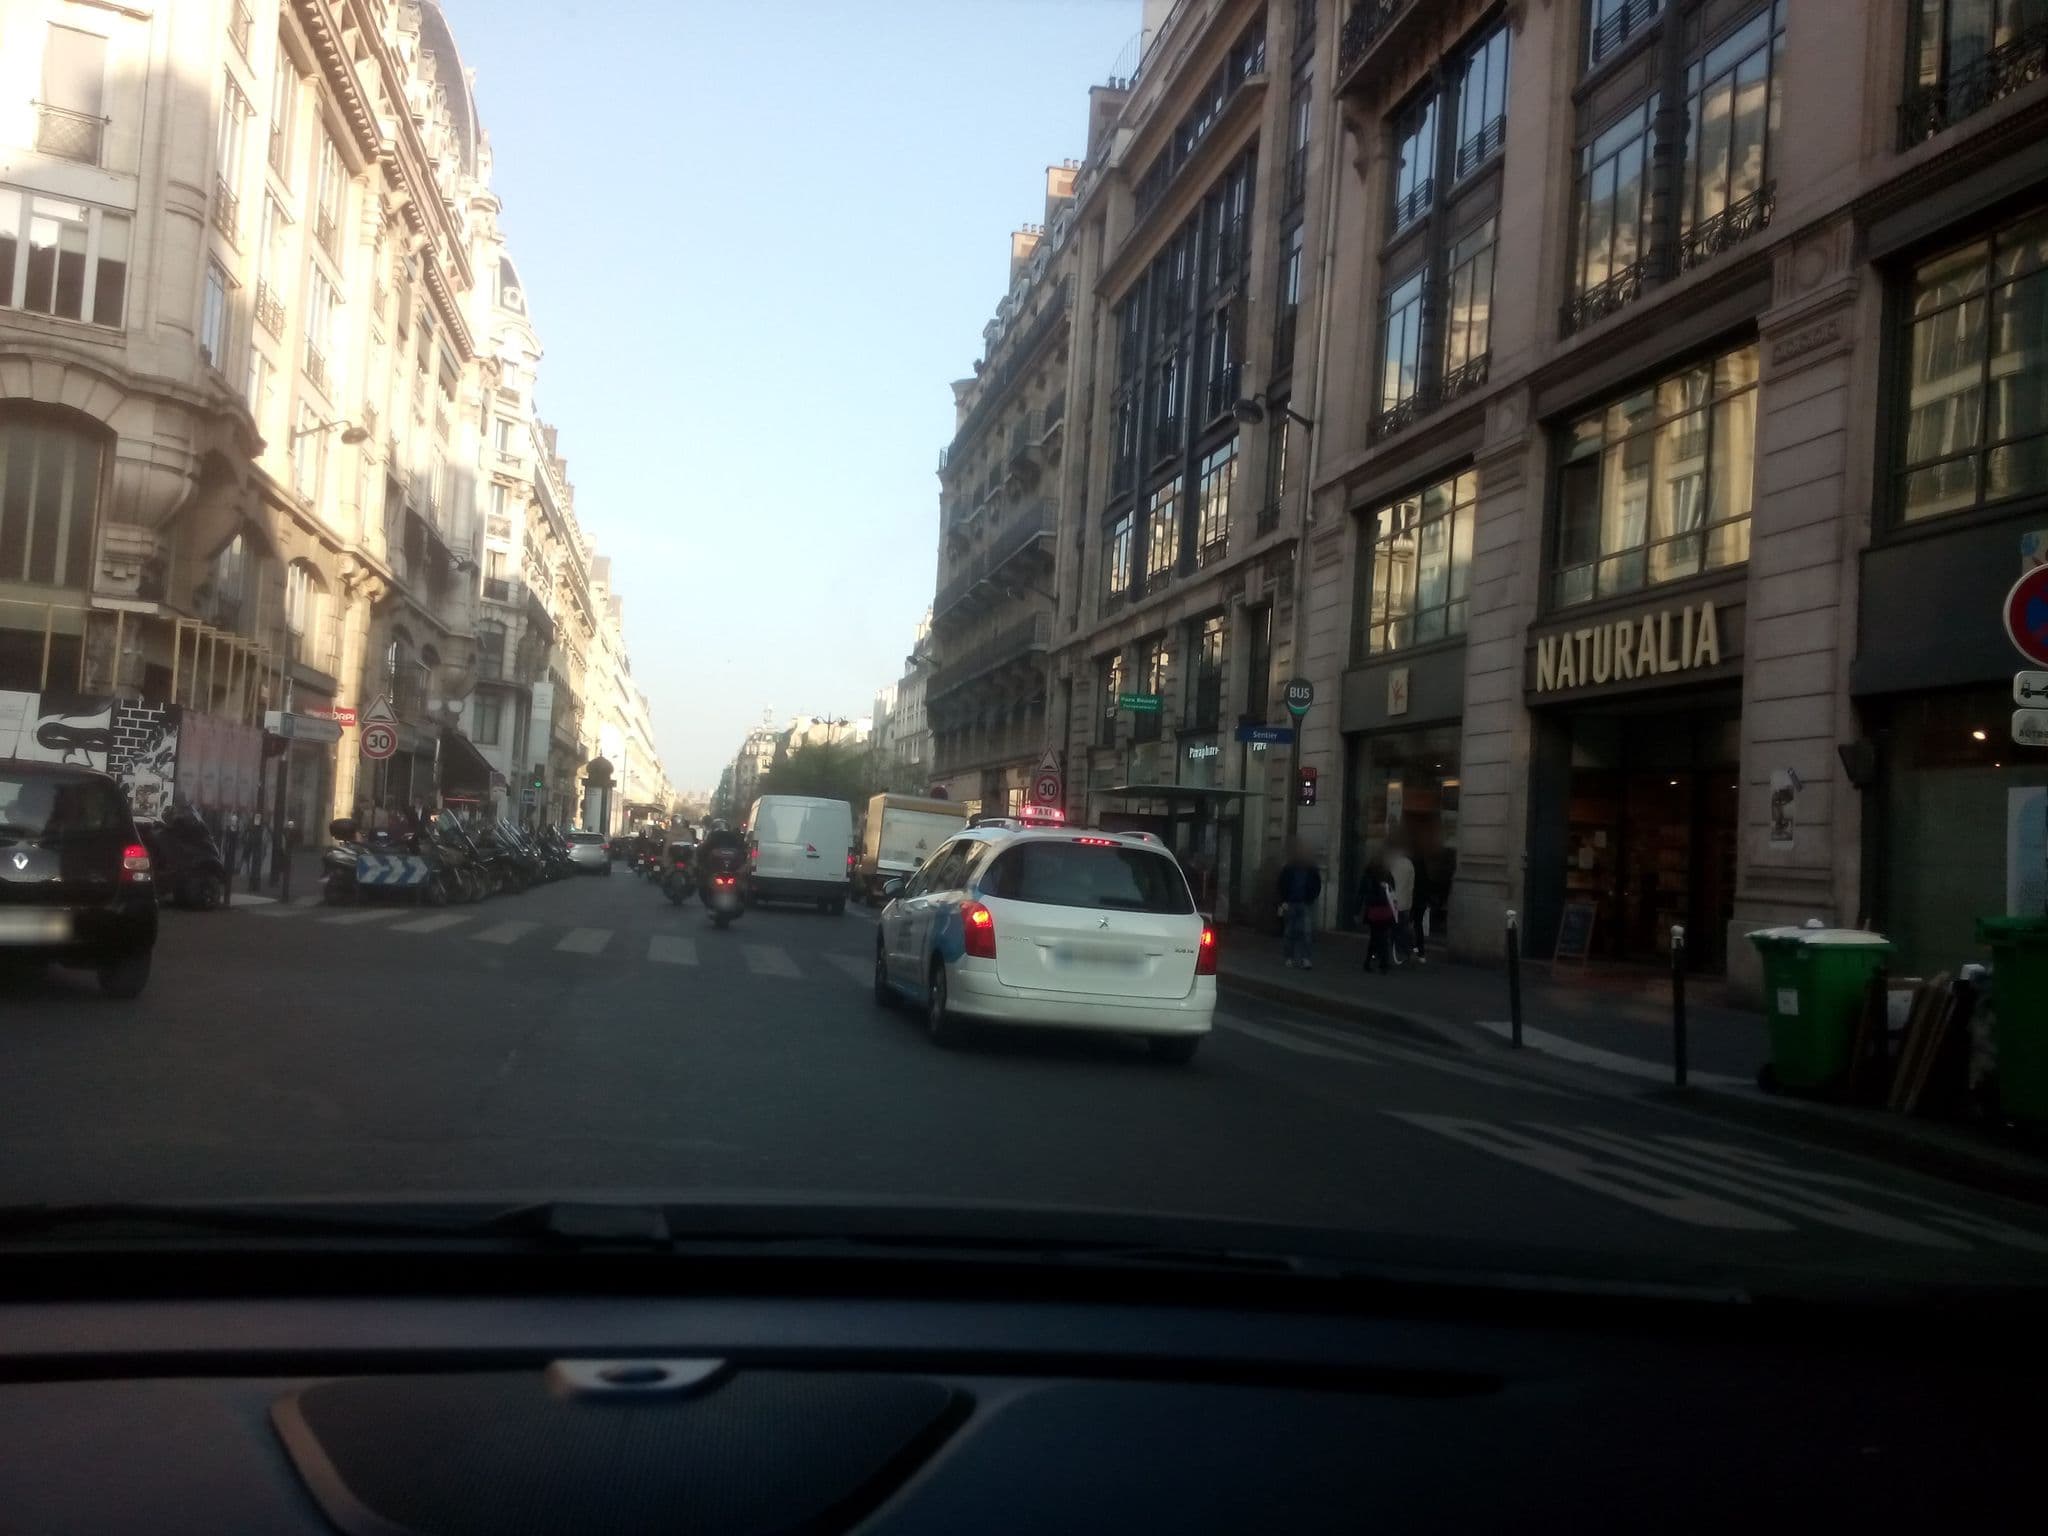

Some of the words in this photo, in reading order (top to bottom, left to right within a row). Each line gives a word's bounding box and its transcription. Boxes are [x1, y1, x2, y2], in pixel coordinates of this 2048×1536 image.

[1537, 601, 1719, 693] NATURALIA
[1289, 687, 1310, 699] BUS
[1253, 731, 1278, 739] Sentier
[368, 734, 390, 749] 30
[1040, 783, 1055, 796] 30
[1033, 808, 1052, 817] TAXI
